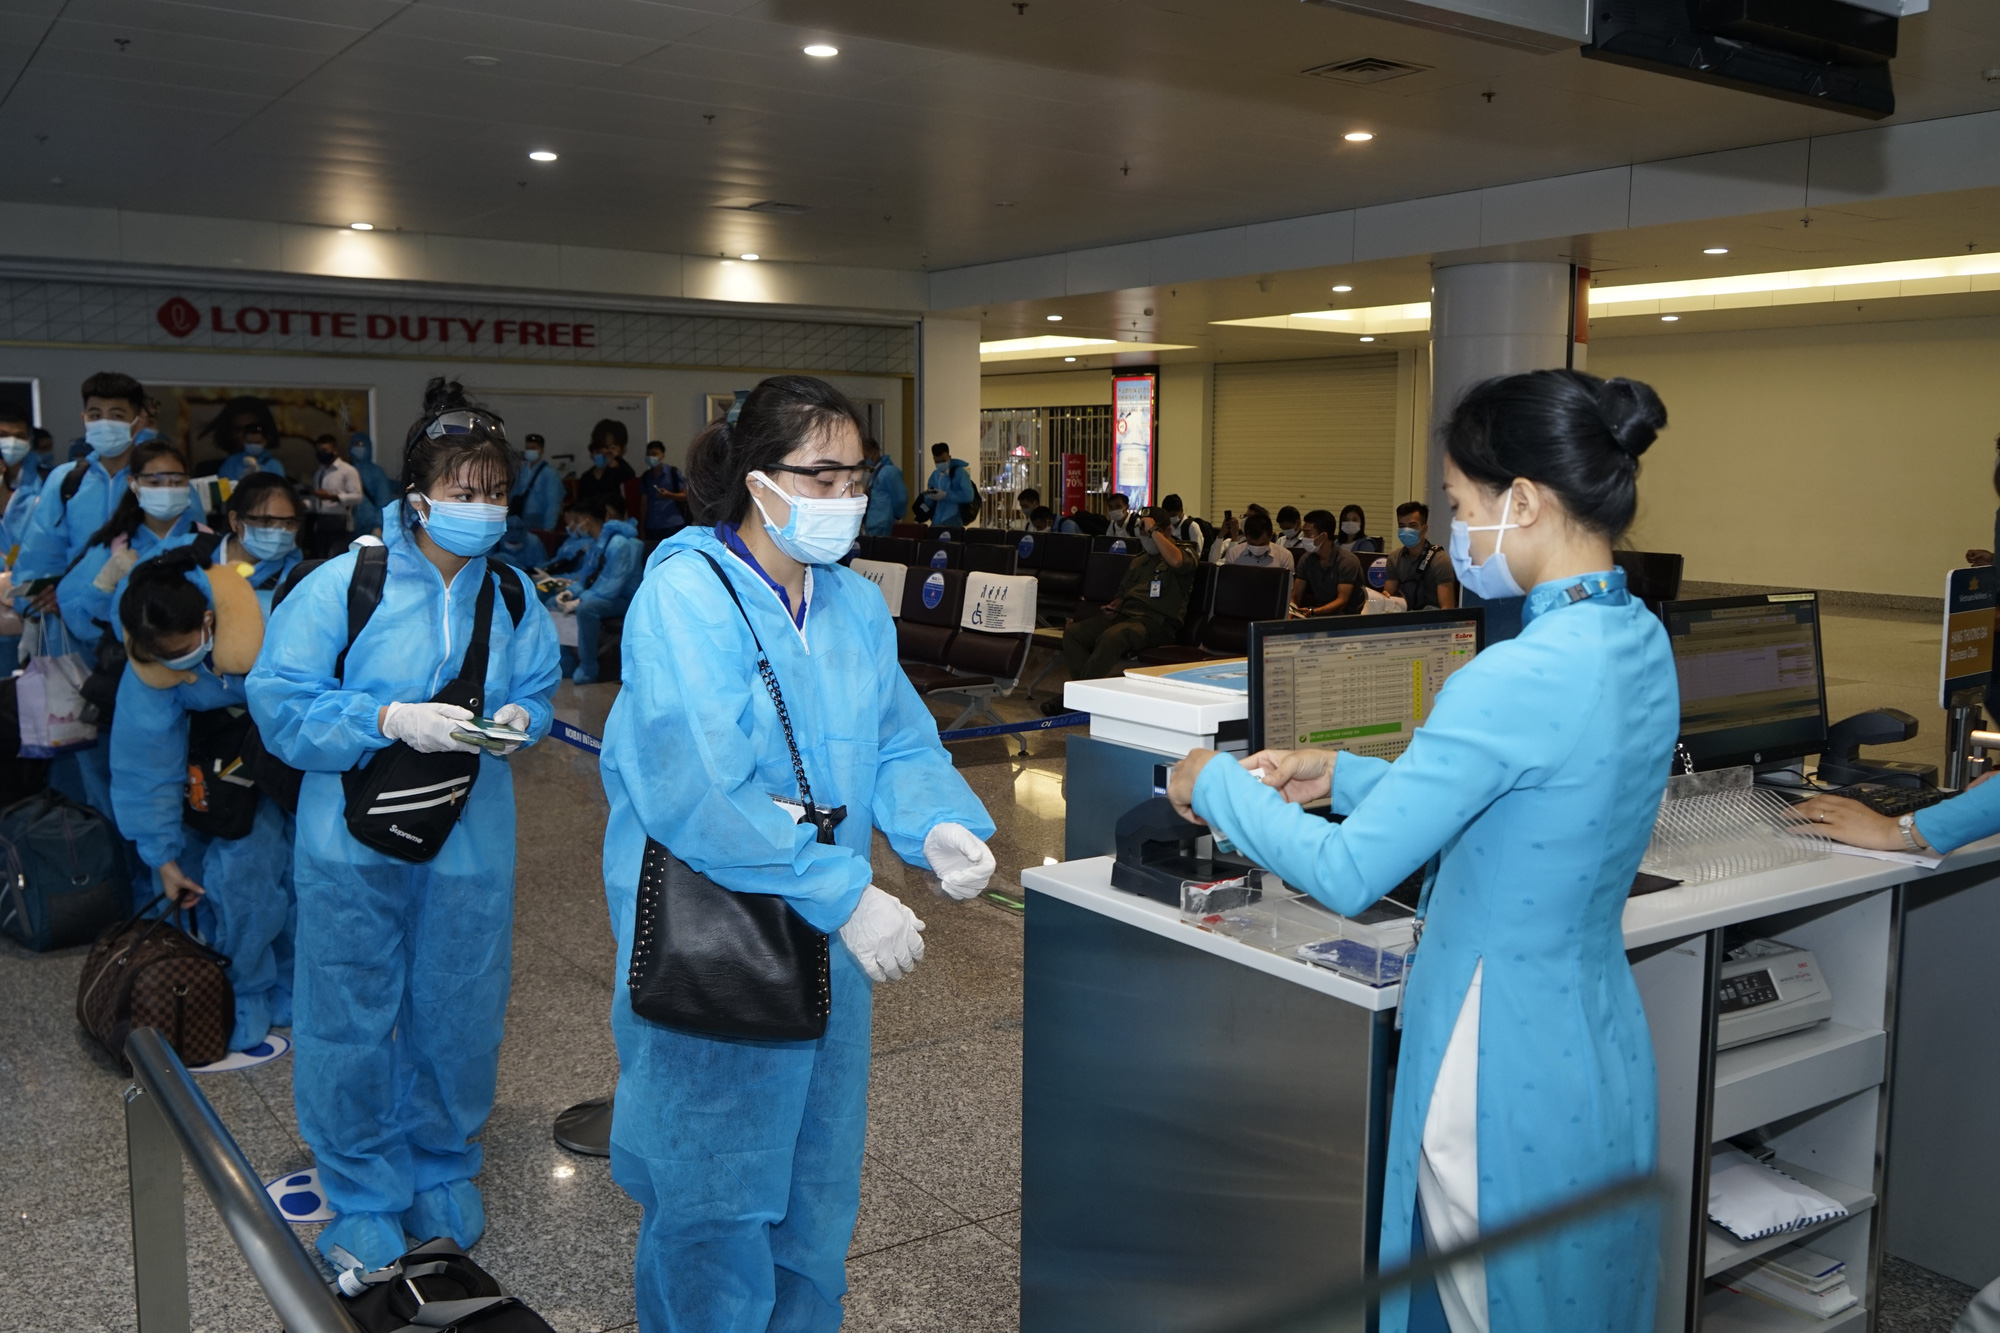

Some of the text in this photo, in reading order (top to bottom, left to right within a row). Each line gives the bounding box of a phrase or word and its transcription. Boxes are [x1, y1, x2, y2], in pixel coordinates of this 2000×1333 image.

[210, 305, 597, 348] LOTTE DUTY FREE
[1066, 478, 1083, 488] 70%
[1949, 646, 1979, 662] Business Class
[389, 824, 423, 844] Supreme
